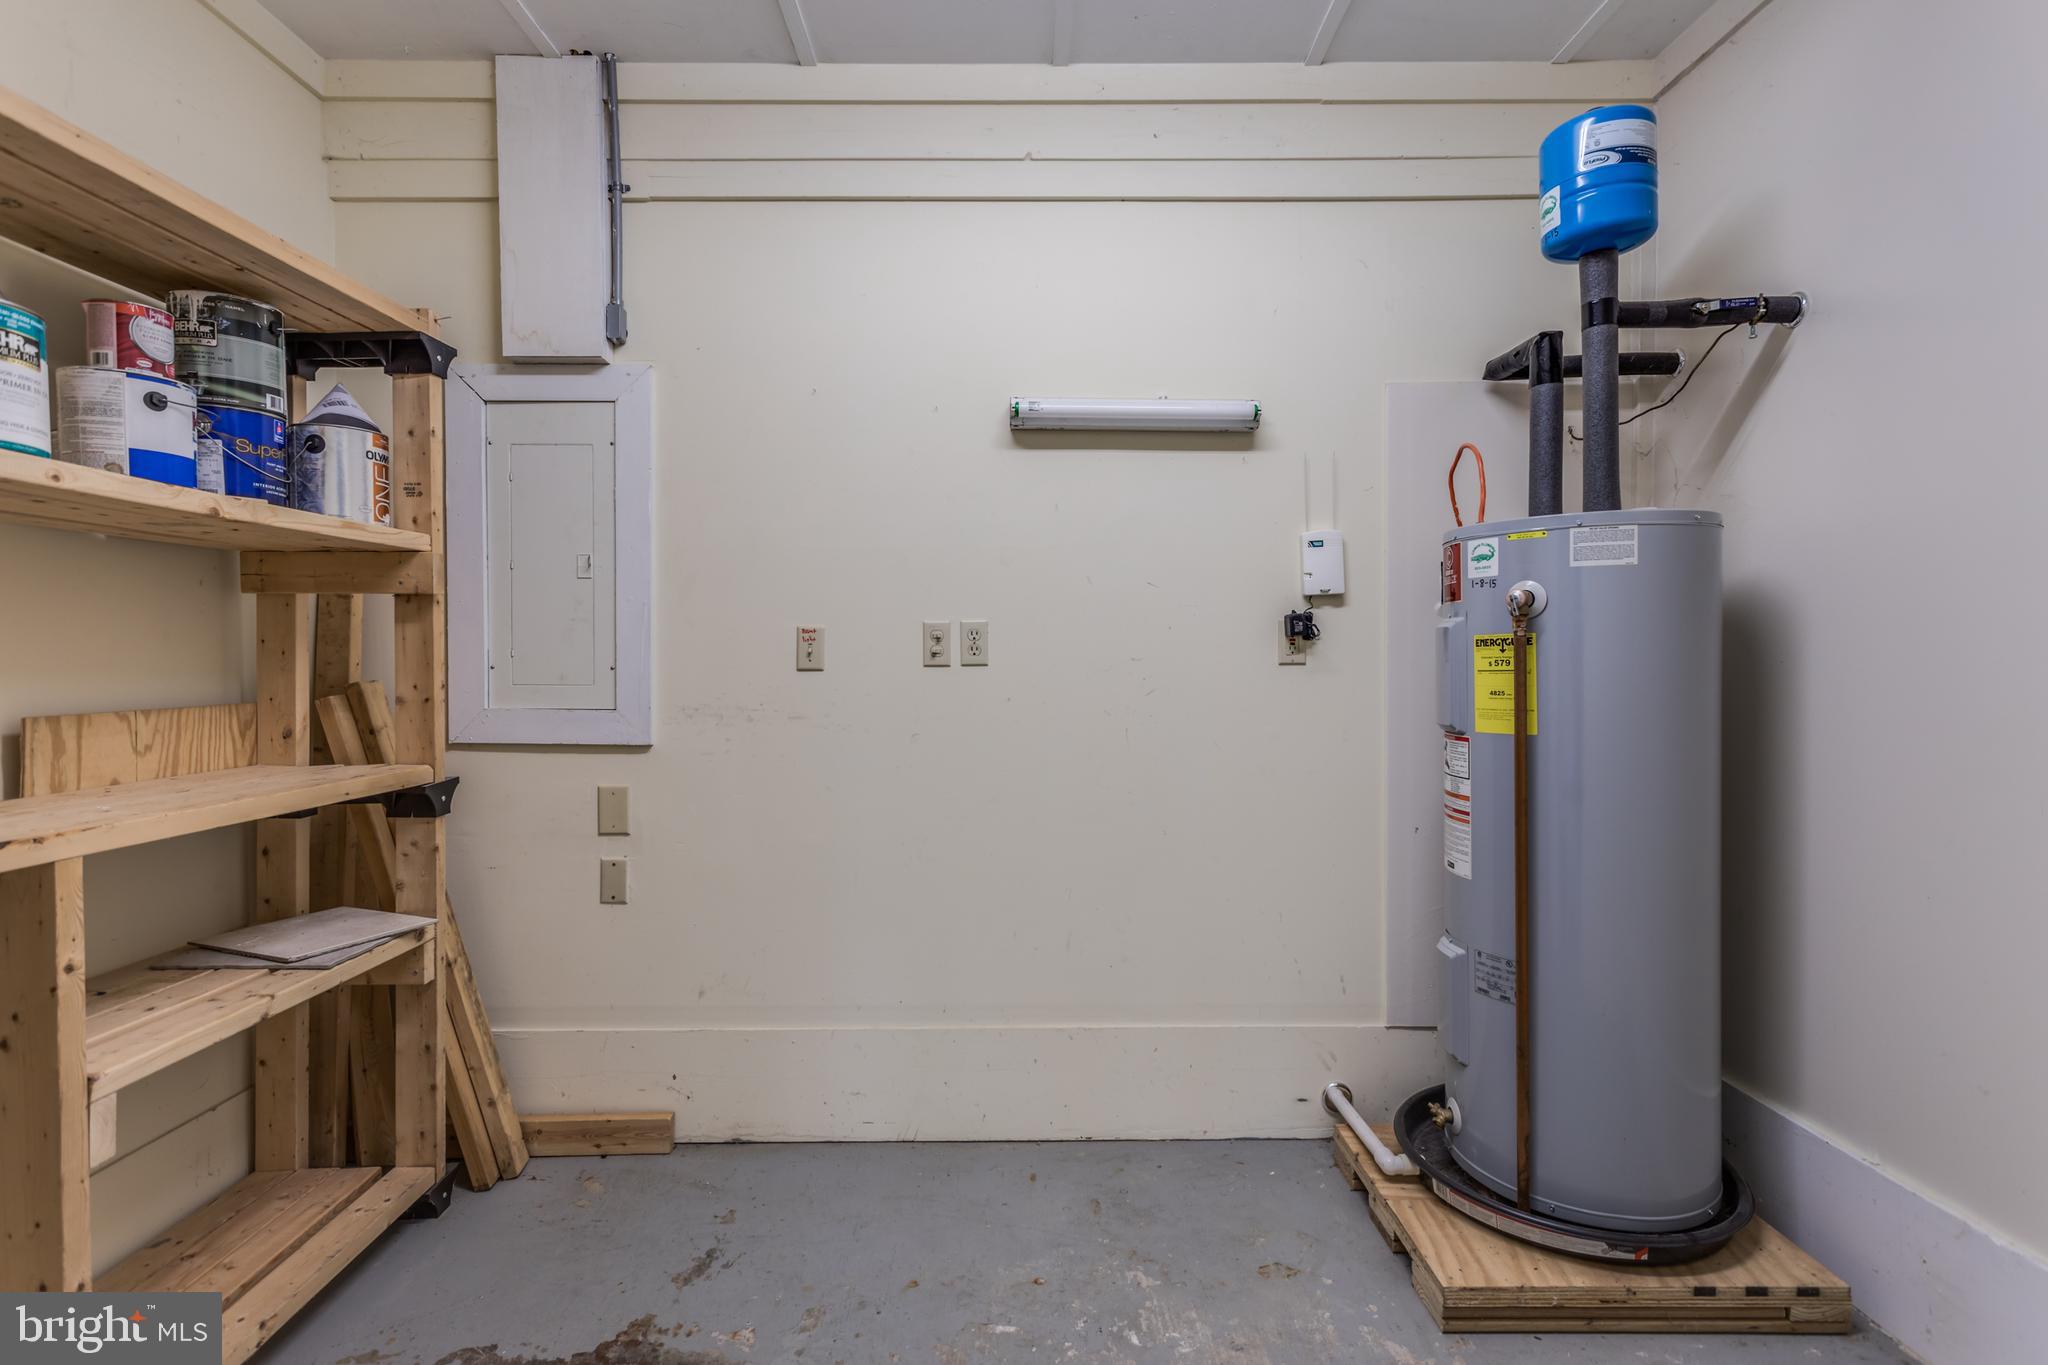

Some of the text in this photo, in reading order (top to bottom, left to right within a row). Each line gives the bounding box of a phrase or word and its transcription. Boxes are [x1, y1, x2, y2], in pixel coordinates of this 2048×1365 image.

[174, 321, 199, 332] BEHR
[0, 330, 24, 352] HR
[366, 450, 389, 464] OLYM
[1471, 579, 1497, 588] 1-8-15
[1475, 637, 1533, 648] ENERGYGE
[1494, 659, 1511, 667] 579
